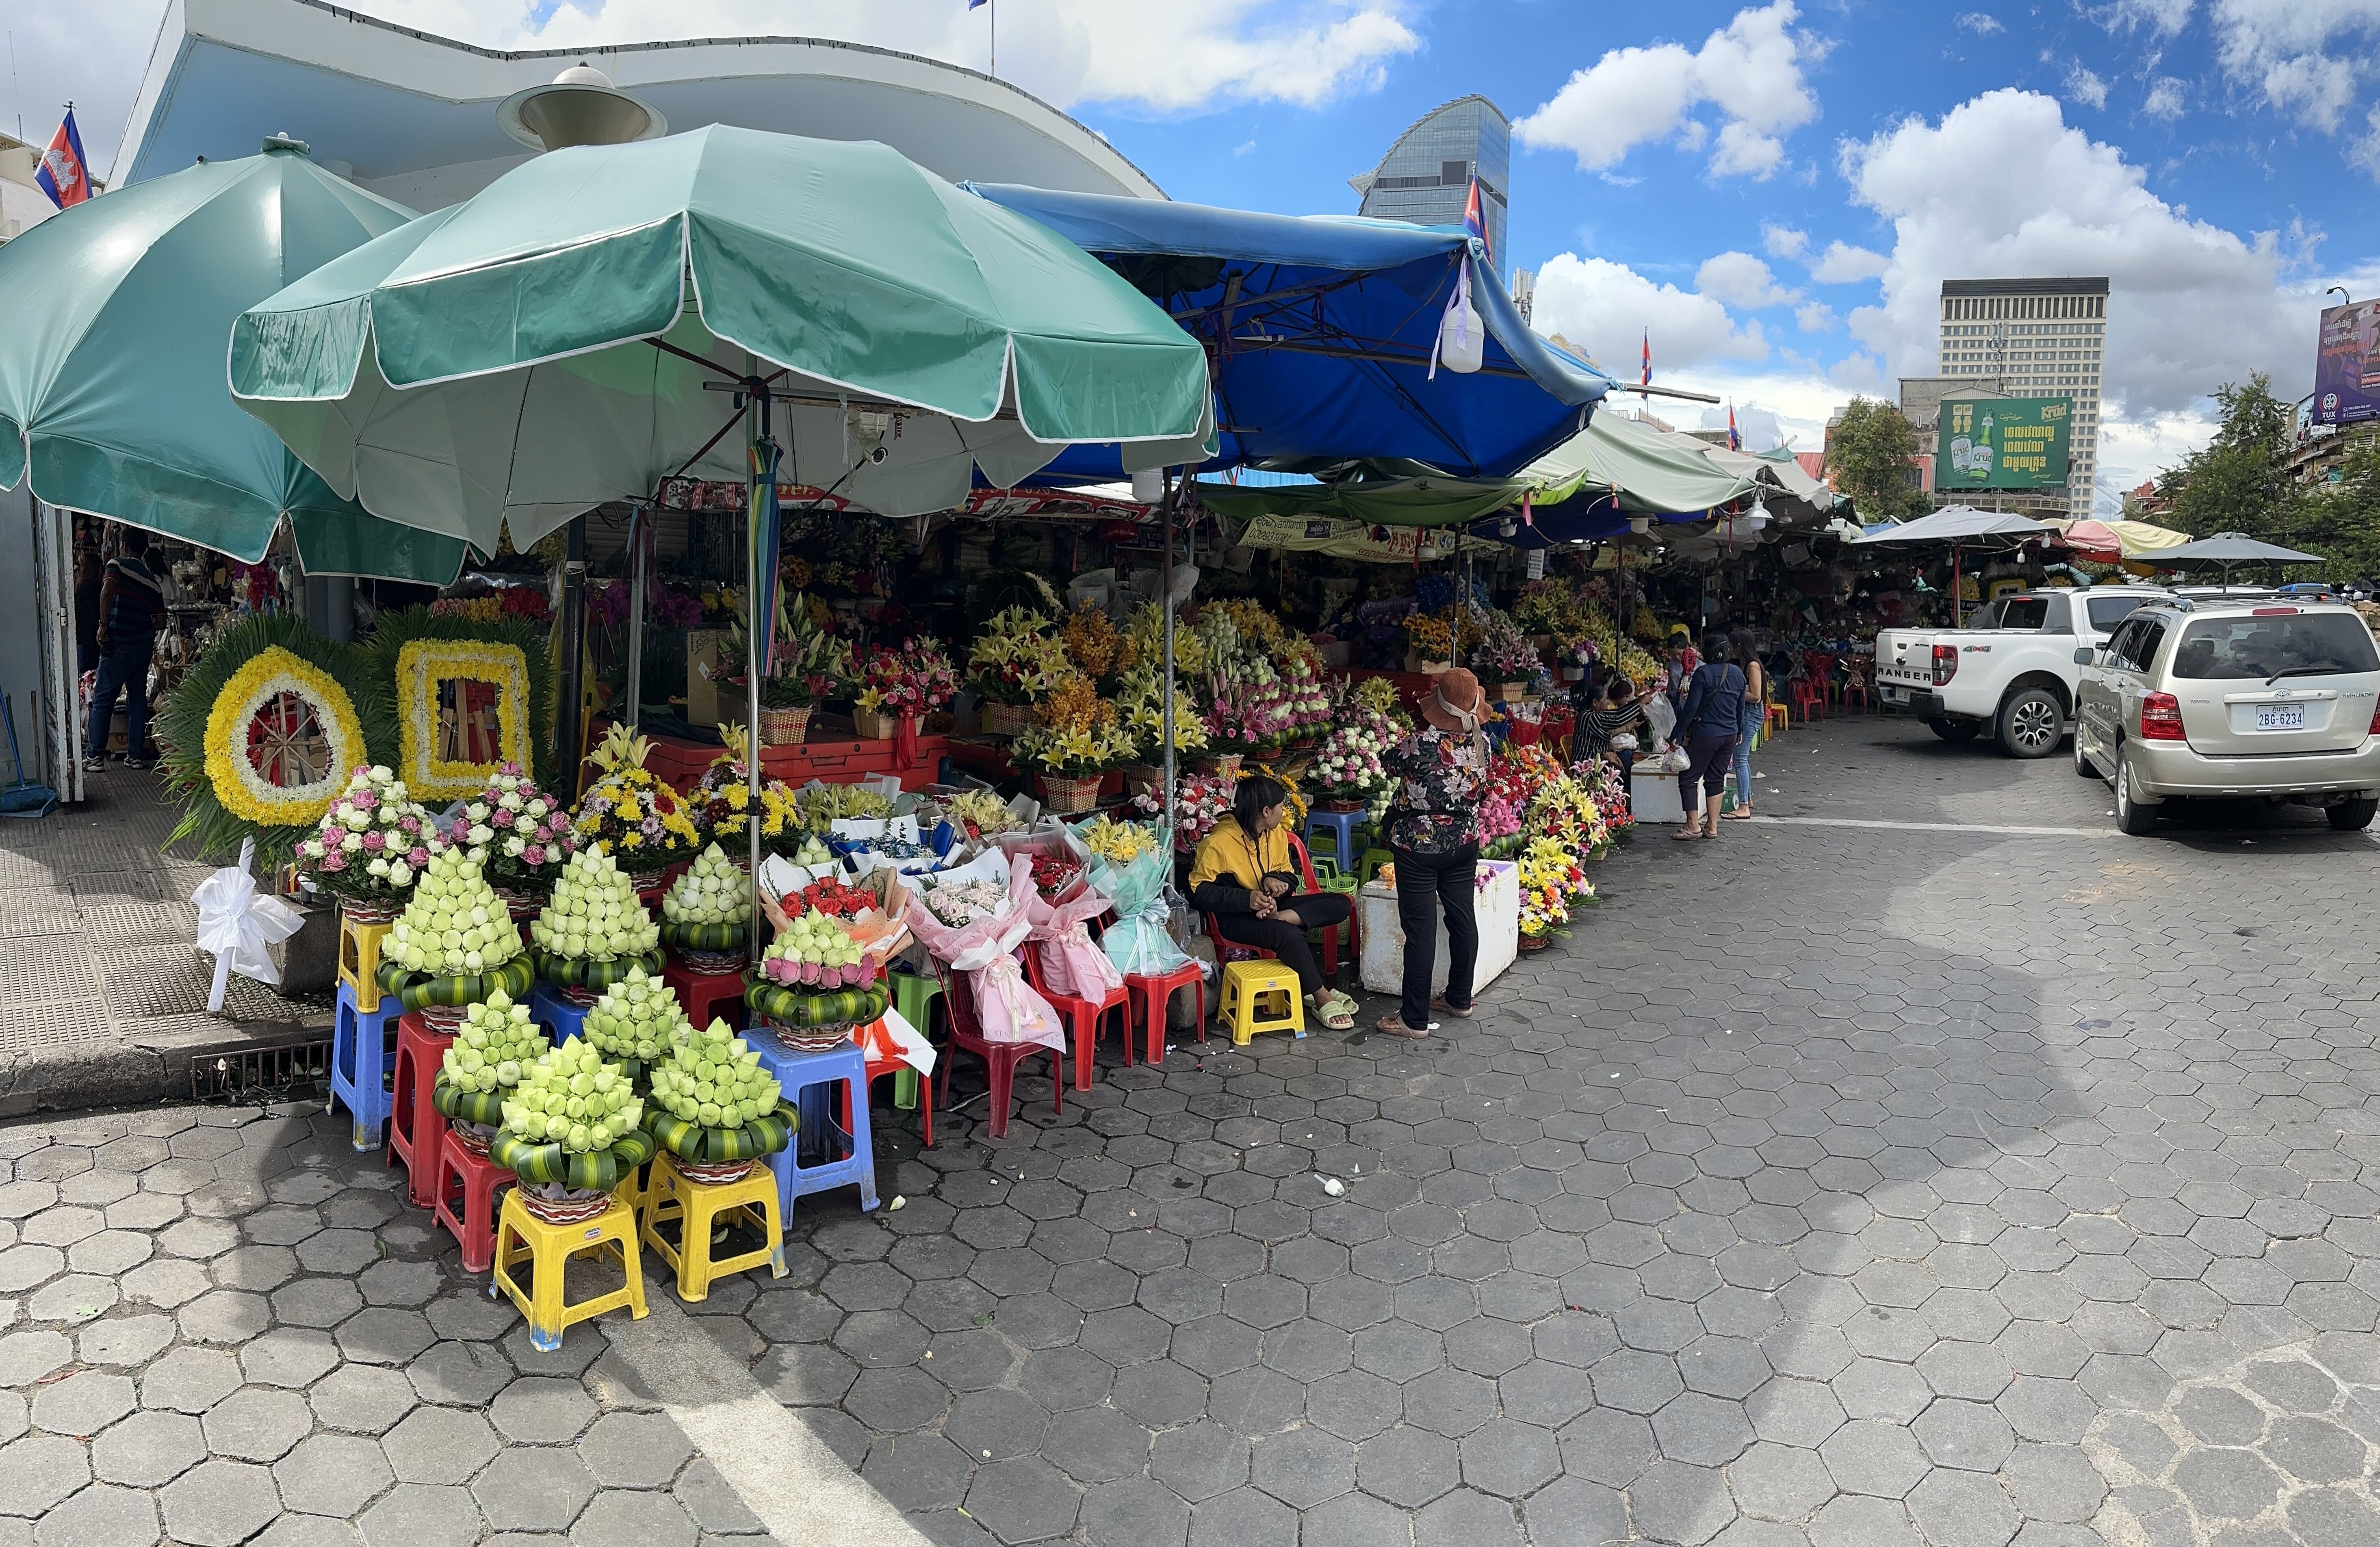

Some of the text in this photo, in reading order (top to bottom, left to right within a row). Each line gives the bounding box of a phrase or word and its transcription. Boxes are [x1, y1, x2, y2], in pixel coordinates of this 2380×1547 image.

[1973, 453, 1992, 462] Krud
[1878, 667, 1931, 681] RANGER
[2259, 713, 2302, 725] 2BG-6234
